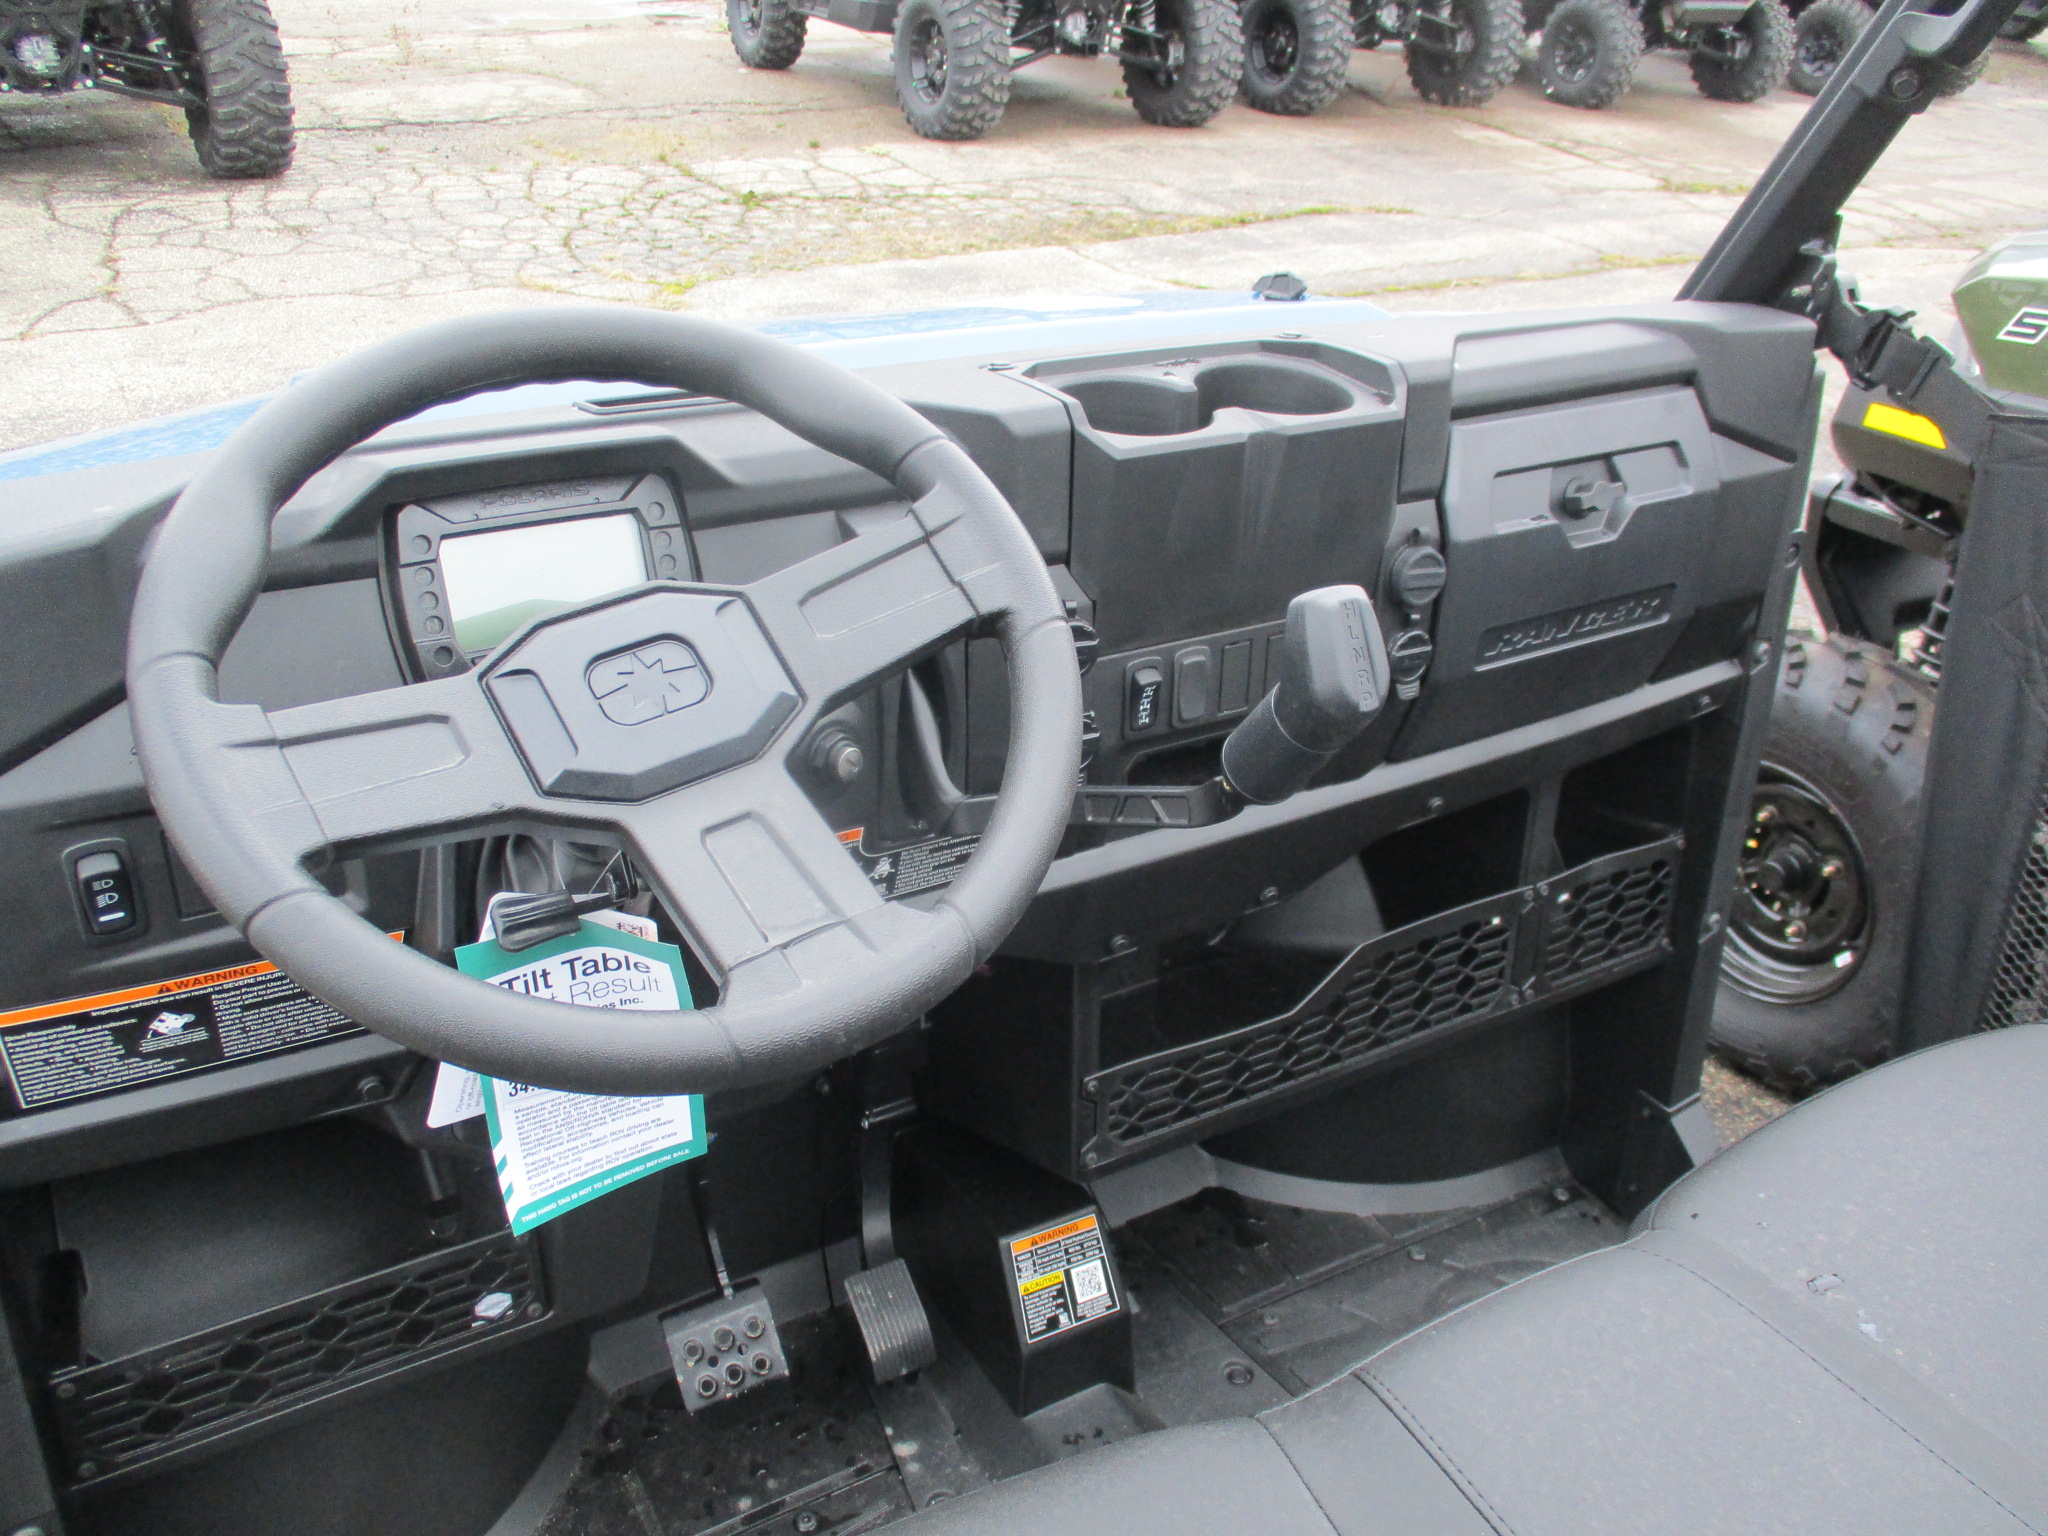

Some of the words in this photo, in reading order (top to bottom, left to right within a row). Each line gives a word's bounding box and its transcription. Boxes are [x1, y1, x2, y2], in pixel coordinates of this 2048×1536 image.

[481, 482, 589, 508] POLARIS
[1485, 598, 1661, 656] RANGER
[173, 964, 258, 990] WARNING
[499, 968, 553, 995] Tilt
[561, 953, 651, 981] Table
[91, 1006, 129, 1016] Improper
[130, 999, 159, 1008] vehicle
[191, 987, 213, 996] result
[222, 978, 255, 989] SEVERE
[211, 990, 240, 999] Require
[263, 991, 293, 1000] careless
[266, 984, 294, 994] prevent
[569, 975, 663, 1004] Result
[259, 1002, 294, 1011] operators
[259, 1009, 285, 1017] driver's
[286, 1003, 313, 1011] license.
[619, 997, 644, 1007] Inc.
[294, 1010, 327, 1019] operation
[219, 1024, 244, 1032] people
[514, 1095, 562, 1114] Measurement
[515, 1113, 545, 1125] operator
[547, 1107, 561, 1115] and
[521, 1106, 548, 1117] sample,
[550, 1095, 581, 1108] standard
[518, 1120, 558, 1135] accordance
[560, 1113, 574, 1121] with
[519, 1133, 532, 1141] test
[554, 1111, 599, 1129] ANSI/ROHVA
[601, 1101, 631, 1114] standard
[519, 1129, 563, 1147] Recreational
[564, 1115, 606, 1132] Off-Highway
[608, 1106, 638, 1117] Vehicles.
[639, 1097, 663, 1107] Vehicle
[521, 1135, 565, 1153] modification,
[566, 1120, 609, 1137] accessories,
[625, 1107, 650, 1118] loading
[526, 1112, 561, 1127] measured
[522, 1149, 542, 1159] affect
[543, 1141, 564, 1152] lateral
[565, 1133, 593, 1144] stability.
[524, 1156, 550, 1168] Training
[552, 1146, 579, 1158] courses
[589, 1134, 608, 1144] teach
[609, 1128, 625, 1137] ROV
[626, 1121, 649, 1131] driving
[525, 1161, 557, 1174] available.
[571, 1140, 609, 1157] information
[611, 1130, 636, 1142] contact
[638, 1126, 652, 1134] your
[653, 1119, 675, 1128] dealer
[527, 1169, 549, 1181] and/or
[550, 1157, 583, 1171] rohva.org.
[529, 1178, 550, 1190] Check
[552, 1171, 565, 1181] with
[567, 1166, 581, 1175] your
[583, 1157, 604, 1168] dealer
[614, 1148, 627, 1156] find
[640, 1137, 659, 1147] about
[660, 1132, 677, 1140] state
[539, 1182, 555, 1193] local
[556, 1177, 571, 1185] laws
[573, 1164, 604, 1178] regarding
[605, 1156, 620, 1165] ROV
[621, 1146, 654, 1159] operation.
[521, 1211, 537, 1223] THIS
[537, 1201, 556, 1215] HANG
[556, 1195, 570, 1206] TAG
[578, 1186, 592, 1196] NOT
[593, 1181, 602, 1189] TO
[603, 1177, 612, 1185] BE
[613, 1164, 645, 1181] REMOVED
[645, 1154, 671, 1167] BEFORE
[672, 1147, 691, 1158] SALE.
[1038, 1223, 1078, 1243] WARNING
[1029, 1273, 1060, 1289] CAUTION
